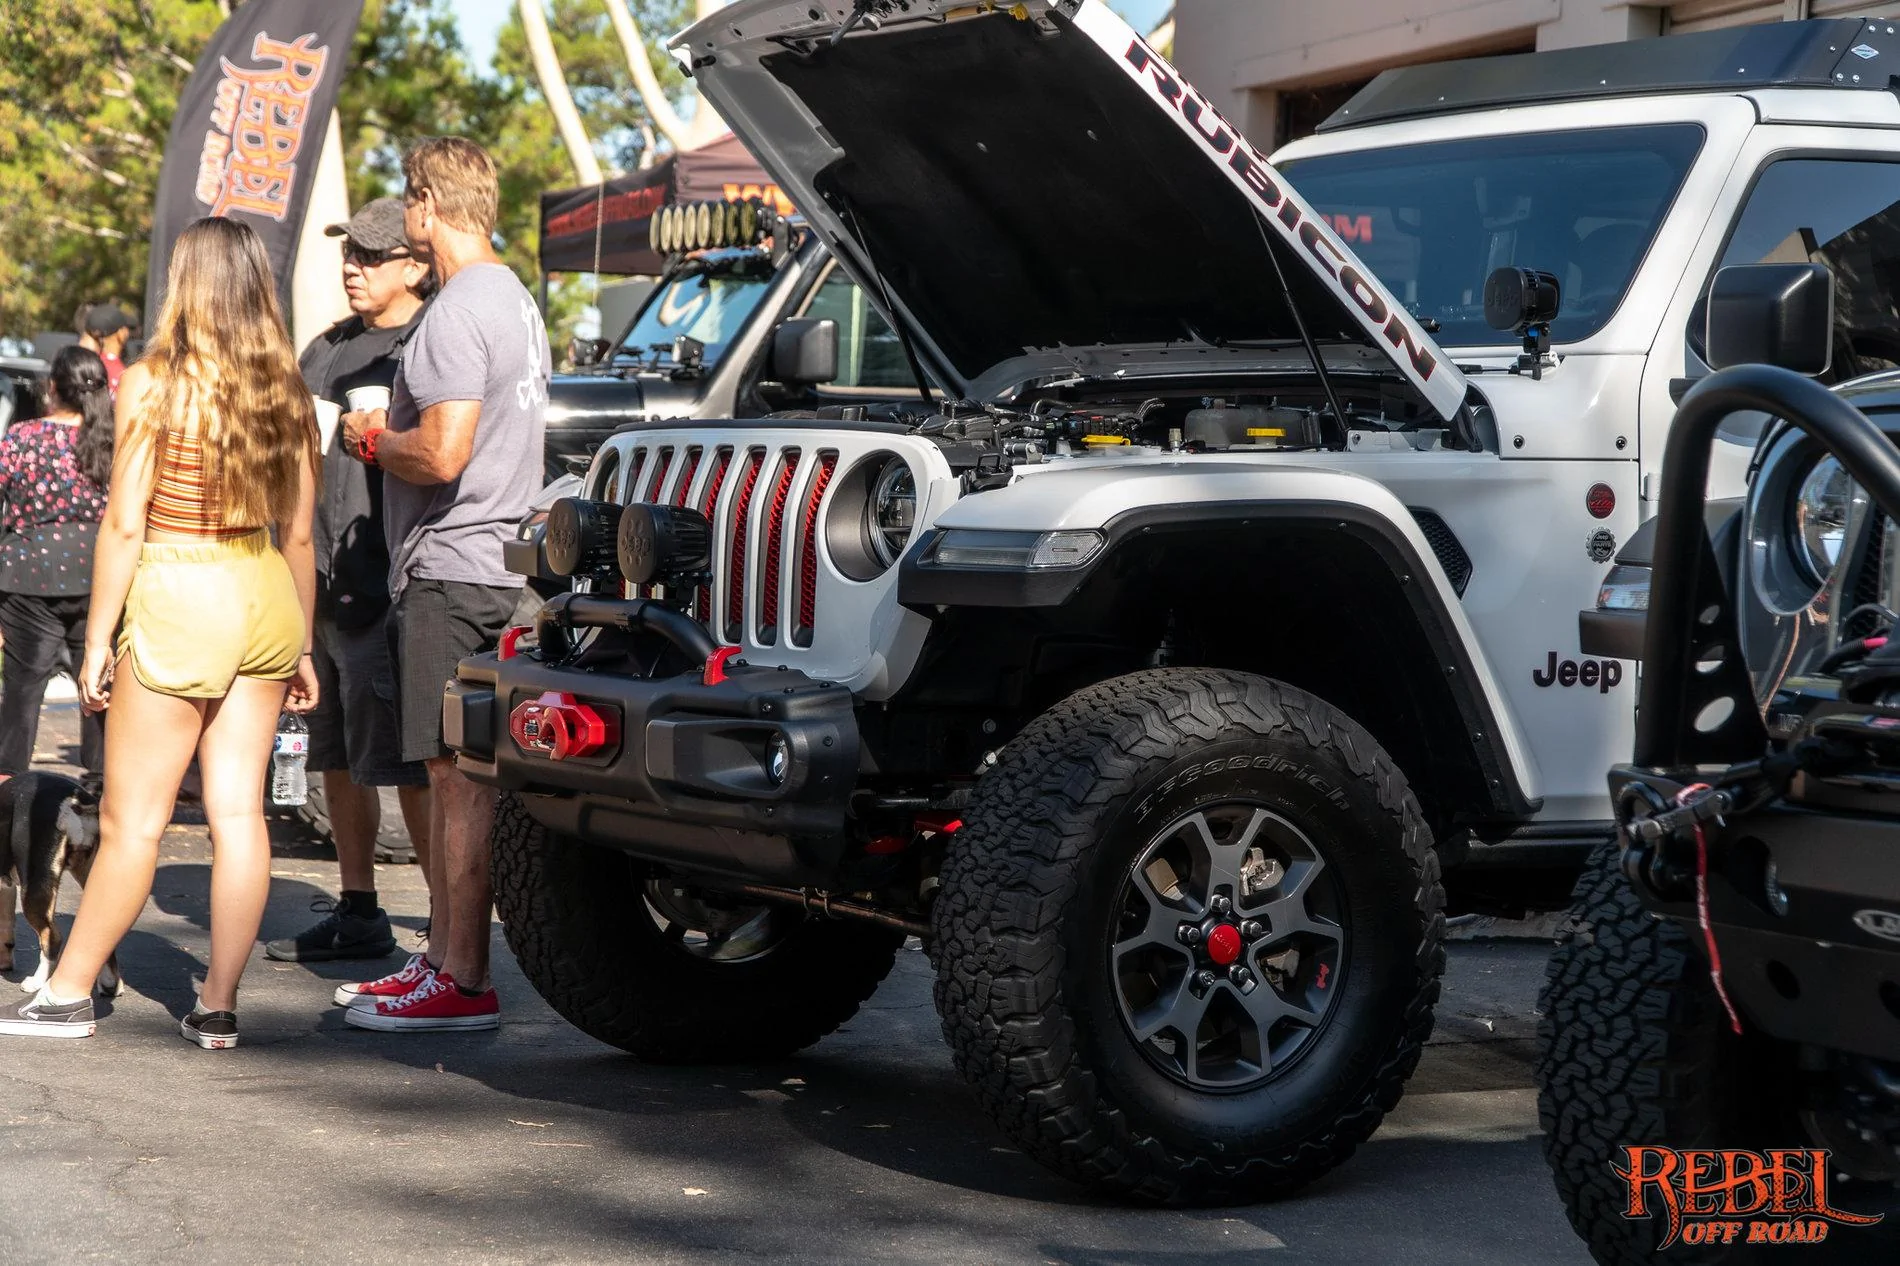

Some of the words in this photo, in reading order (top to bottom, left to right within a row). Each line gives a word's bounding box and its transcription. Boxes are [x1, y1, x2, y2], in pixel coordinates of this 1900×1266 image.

[193, 31, 330, 222] REBEL
[1124, 31, 1437, 382] RUBICON
[1532, 651, 1623, 694] Jeep
